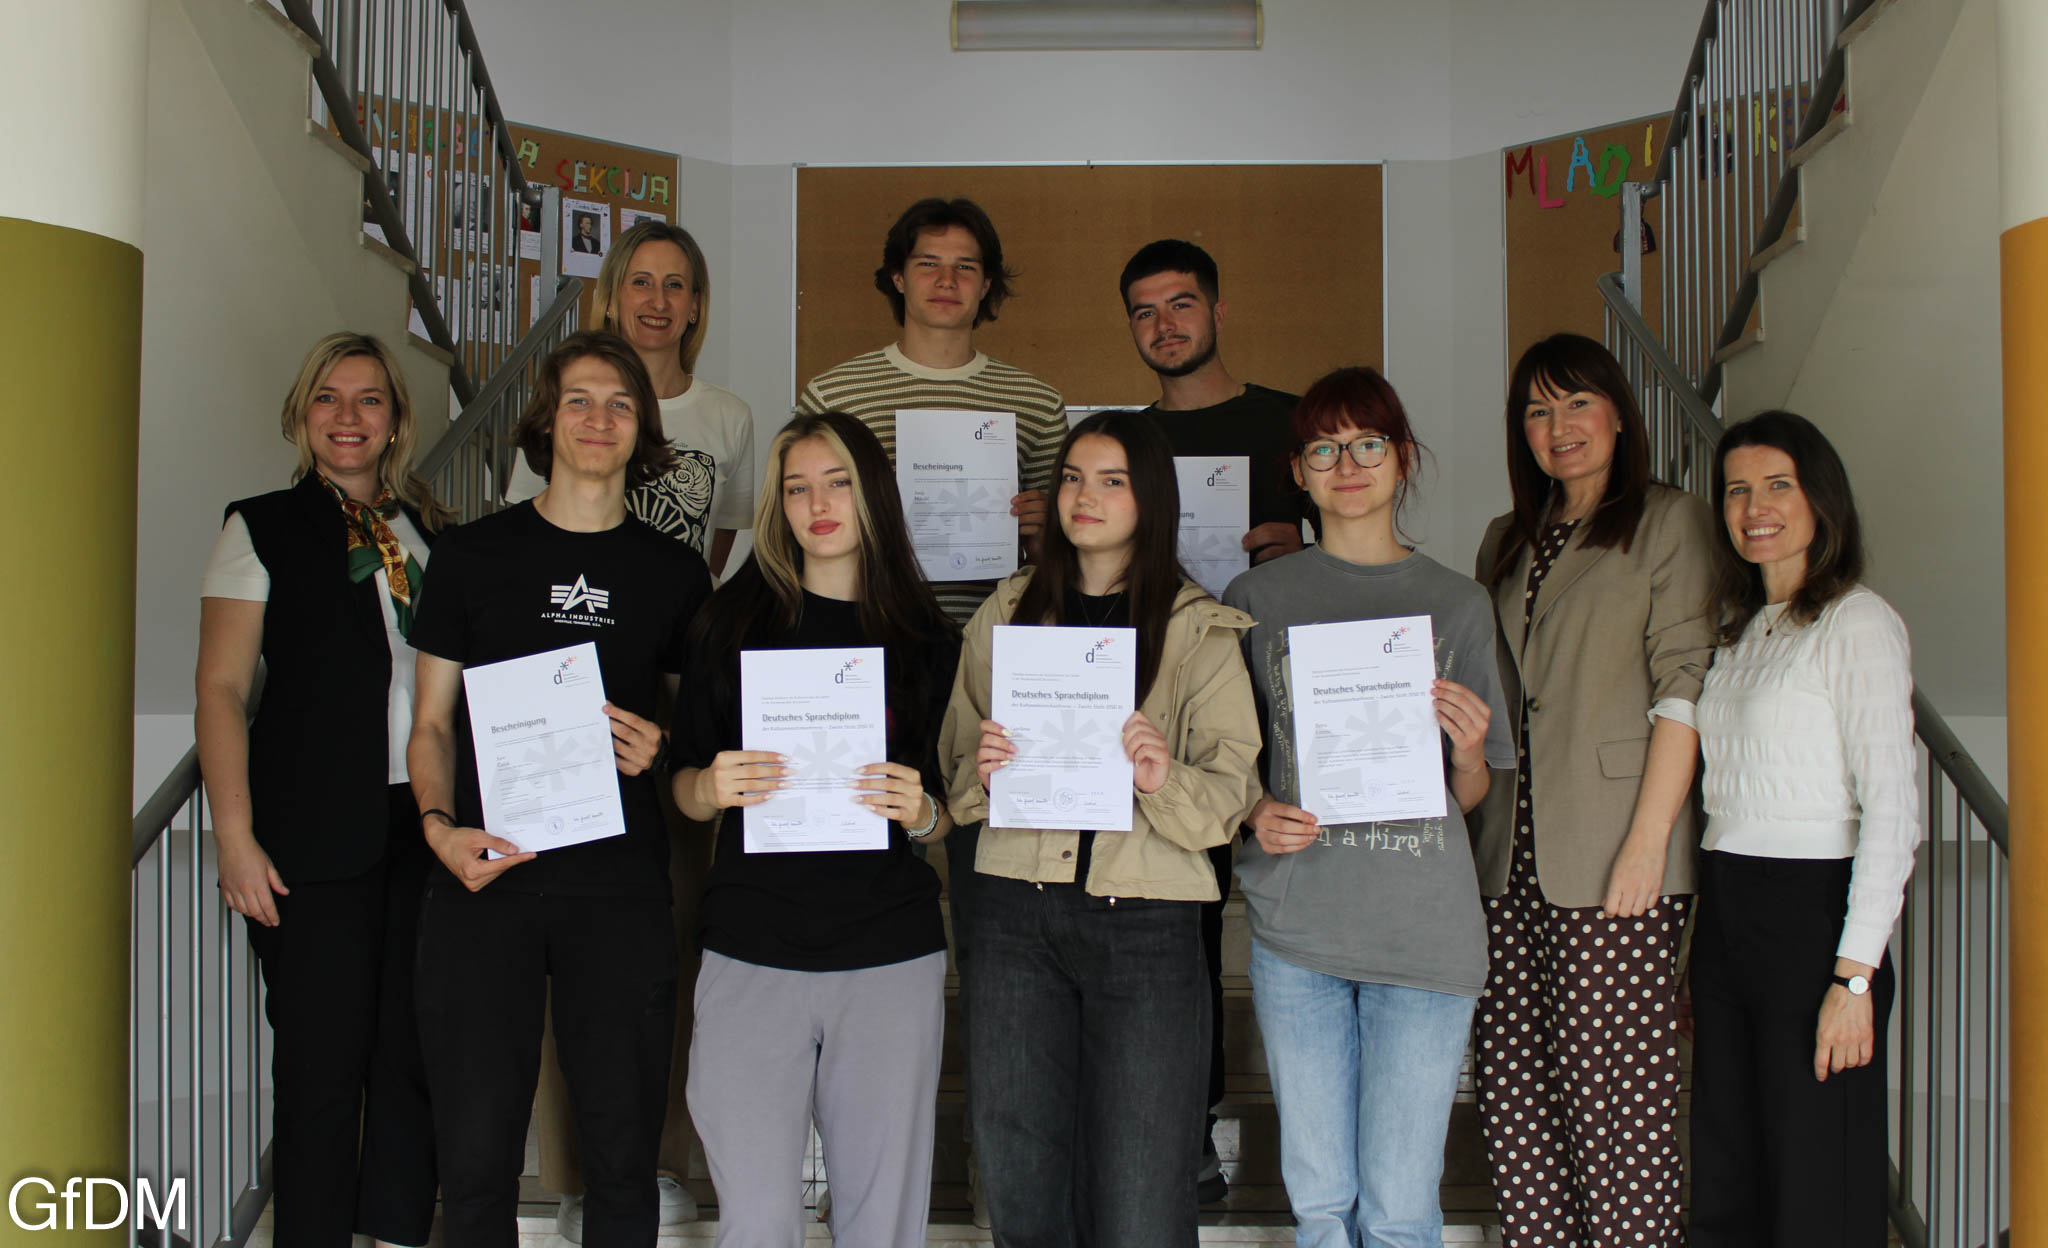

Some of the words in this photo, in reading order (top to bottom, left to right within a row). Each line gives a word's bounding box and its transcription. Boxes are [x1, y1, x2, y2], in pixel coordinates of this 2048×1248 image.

[1506, 123, 1653, 209] MLADI
[555, 159, 670, 205] SEKCIJA
[913, 463, 963, 472] Bescheinigung
[569, 613, 615, 625] INDUSTRIES
[1011, 689, 1052, 699] Deutsches
[1054, 690, 1109, 701] Sprachdiplom
[1313, 686, 1354, 696] Deutsches
[1356, 681, 1411, 693] Sprachdiplom
[762, 713, 803, 722] Deutsches
[805, 712, 860, 723] Sprachdiplom
[491, 716, 547, 734] Bescheinigung
